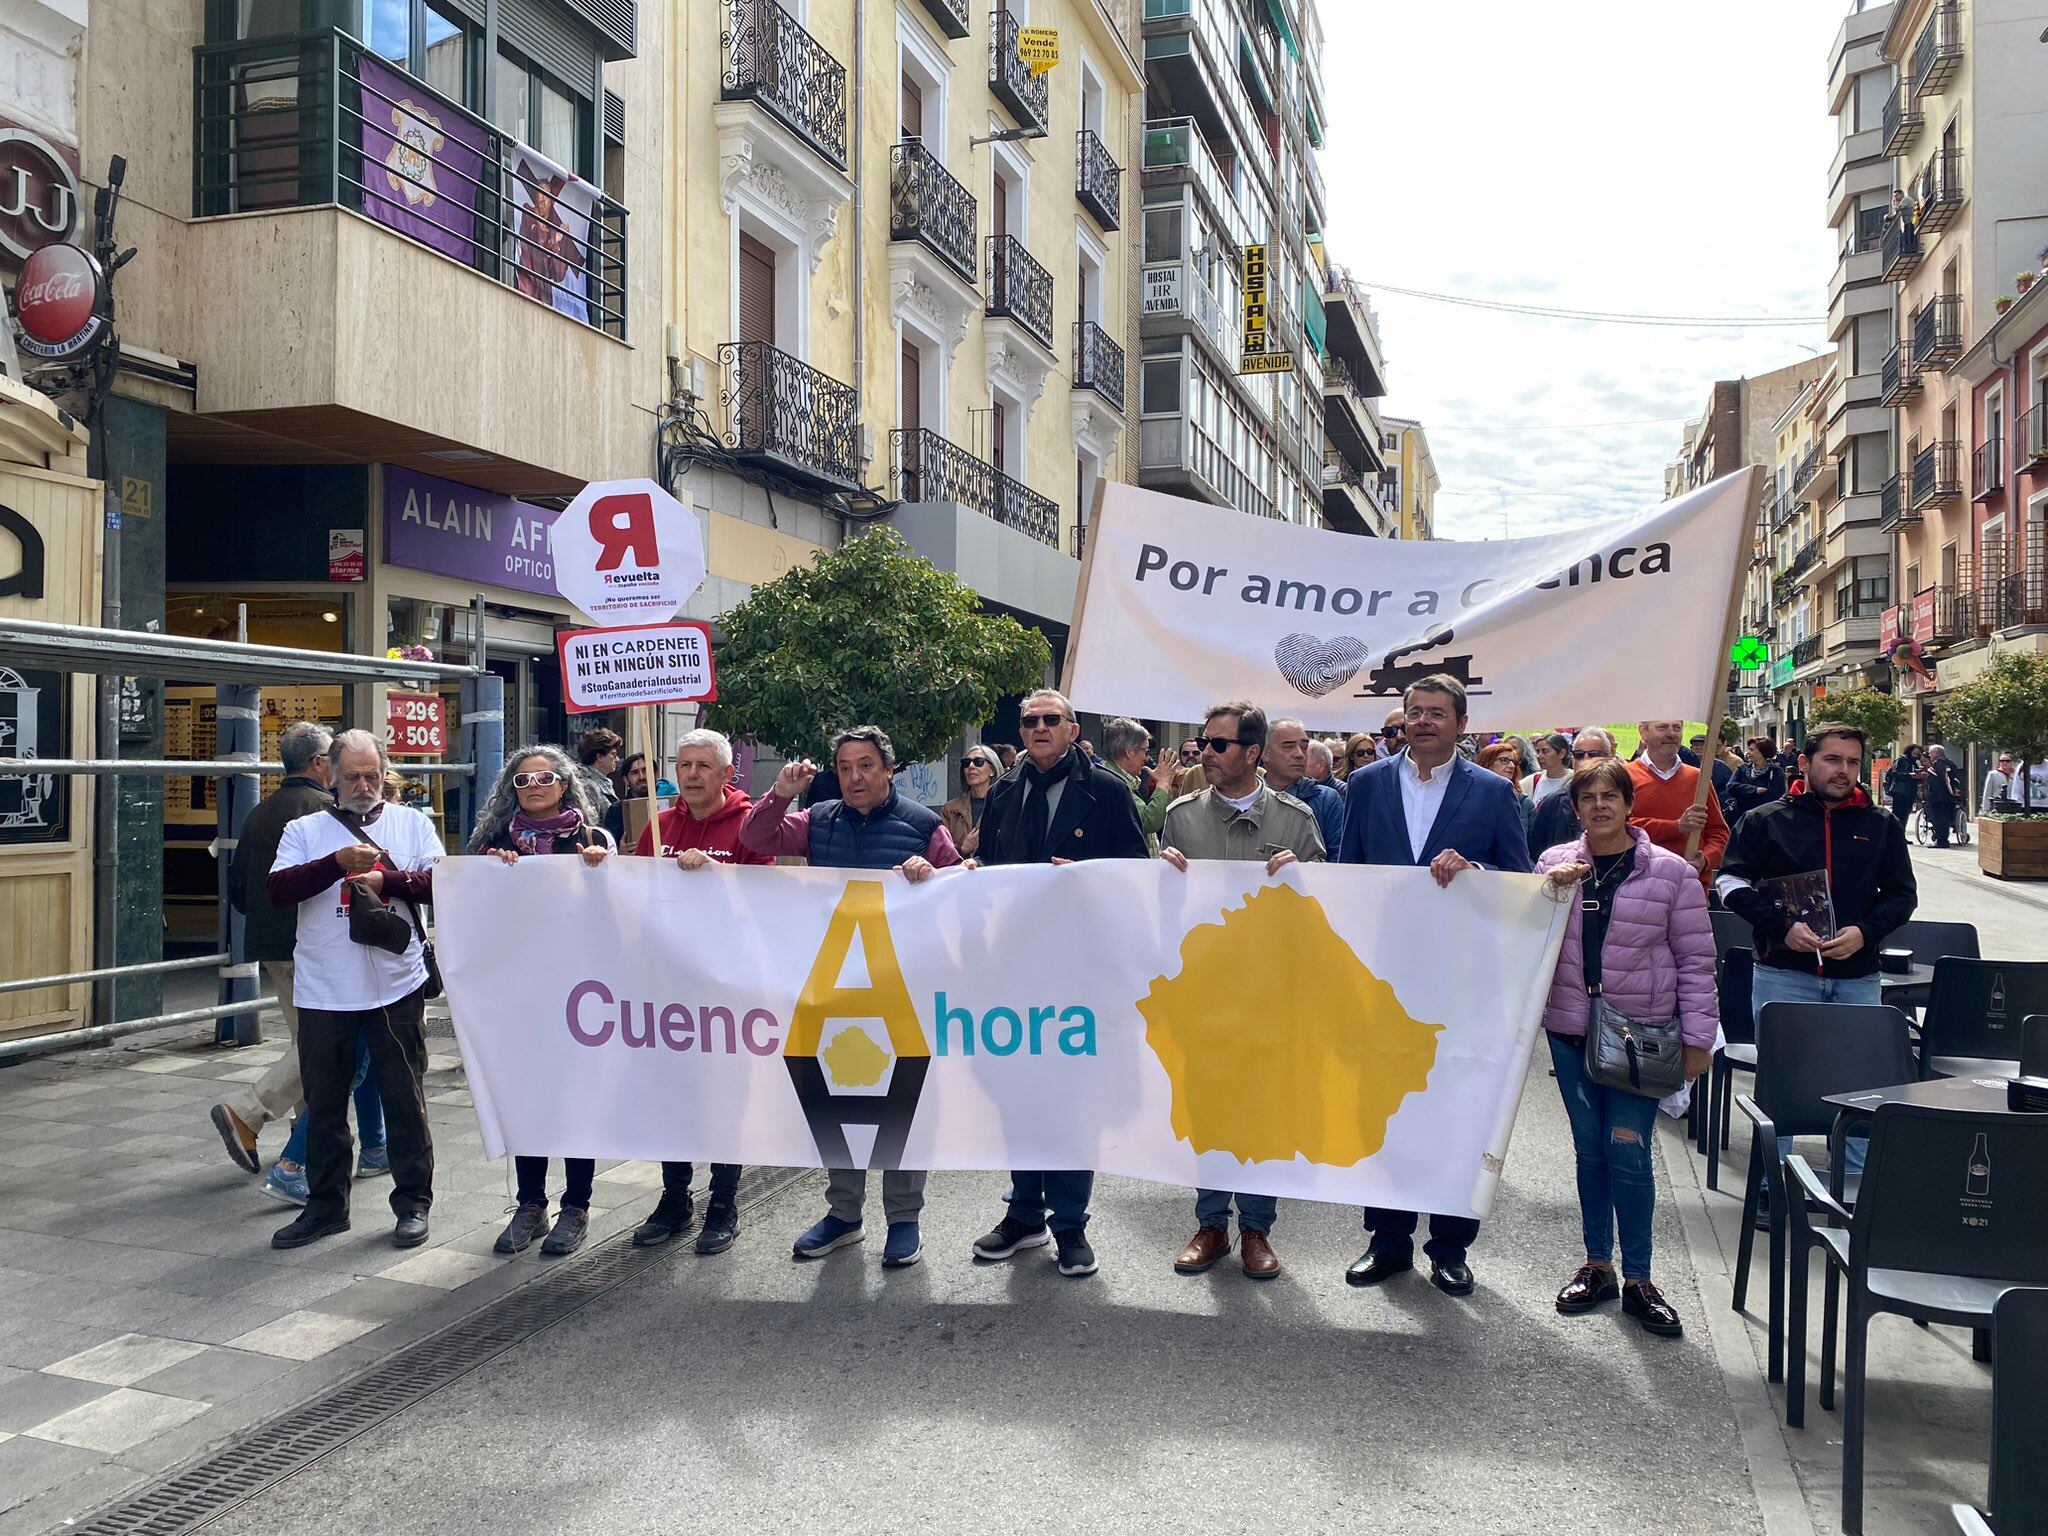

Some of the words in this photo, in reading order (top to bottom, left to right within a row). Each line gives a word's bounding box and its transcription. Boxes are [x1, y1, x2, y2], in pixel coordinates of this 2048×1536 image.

[1023, 36, 1055, 48] Vende
[1019, 48, 1032, 58] 969
[1033, 49, 1041, 58] 22
[1042, 50, 1050, 59] 70
[1147, 269, 1177, 284] HOSTAL
[1247, 247, 1264, 333] HOSTAL
[1144, 297, 1179, 312] AVENIDA
[23, 337, 56, 356] CAFETERIA
[57, 341, 67, 355] LA
[67, 321, 95, 350] MARTINA
[1242, 355, 1290, 371] AVENIDA
[126, 479, 149, 507] 21
[401, 488, 492, 542] ALAIN
[1134, 542, 1228, 596] Por
[1239, 573, 1393, 618] amor
[1407, 588, 1438, 617] a
[590, 603, 628, 611] TERRITORIO
[639, 600, 677, 608] SACRIFICIO!
[617, 594, 650, 603] queremos
[575, 645, 589, 660] NI
[593, 643, 609, 658] EN
[611, 637, 699, 655] CARDENETE
[577, 662, 591, 677] NI
[595, 660, 610, 675] EN
[614, 652, 665, 673] NINGÚN
[668, 653, 701, 668] SITIO
[600, 687, 683, 700] #TerritoriodeSacrificioNo
[396, 705, 402, 715] x
[405, 700, 439, 722] 29€
[385, 724, 396, 745] 2
[397, 731, 404, 740] x
[406, 725, 441, 746] 50€
